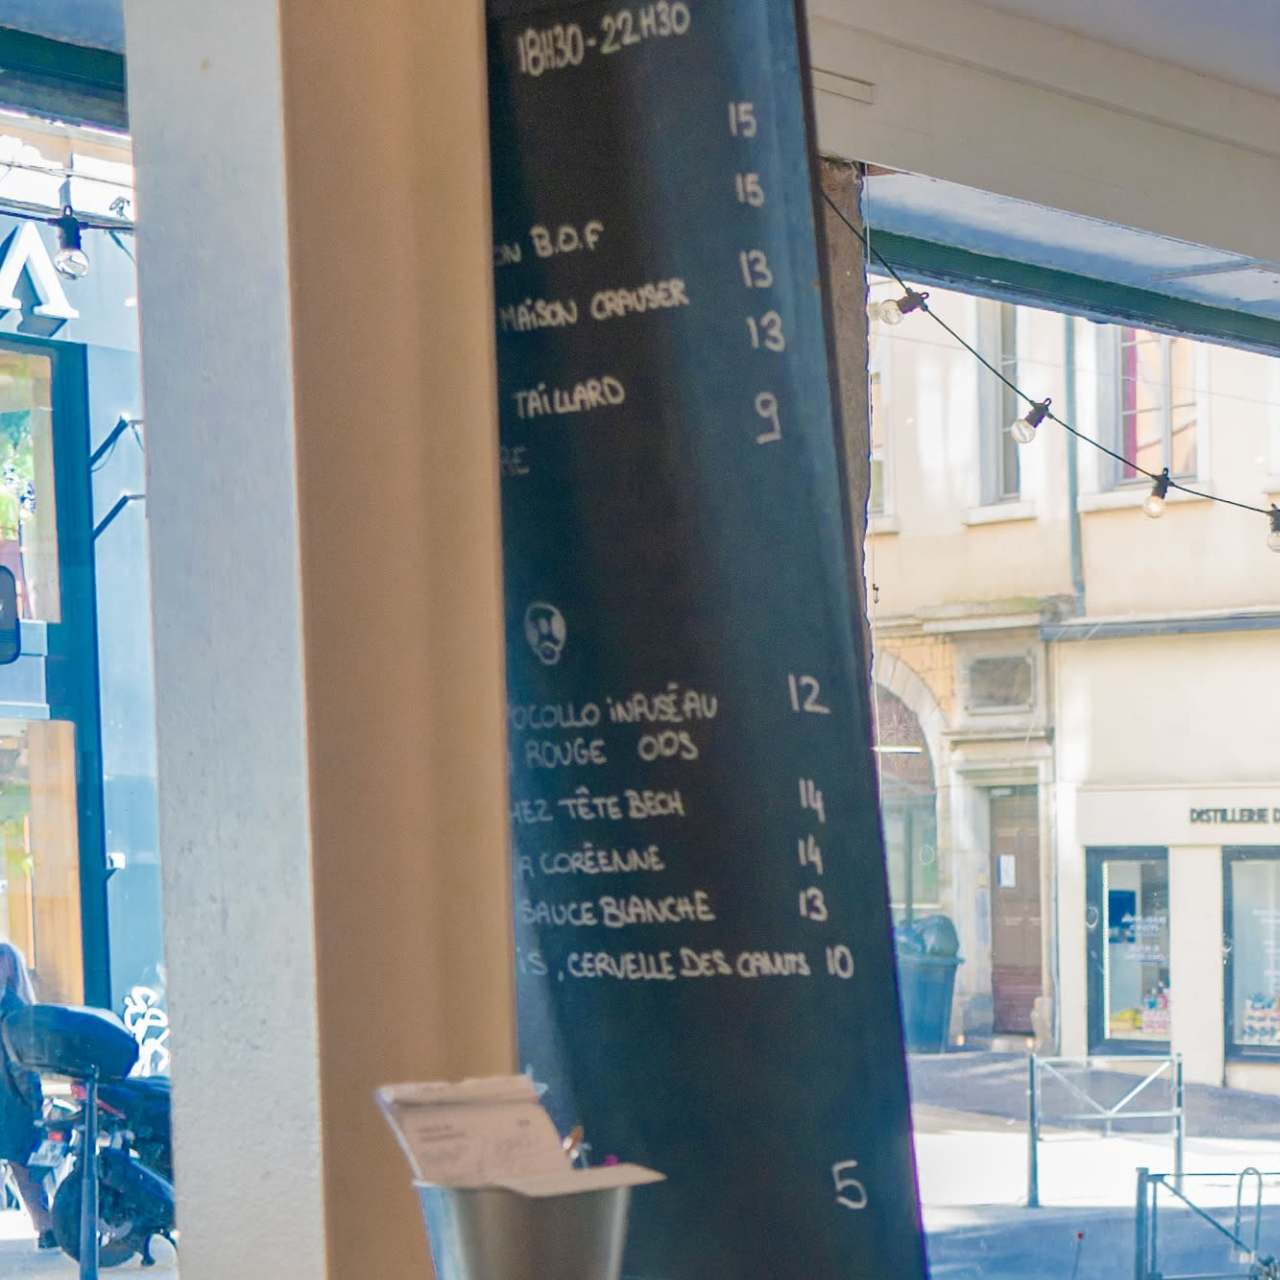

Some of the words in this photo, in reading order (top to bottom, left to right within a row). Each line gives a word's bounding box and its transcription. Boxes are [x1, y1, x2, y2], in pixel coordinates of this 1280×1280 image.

[728, 102, 757, 138] 15
[735, 173, 765, 208] 15
[740, 249, 773, 288] 13
[746, 310, 785, 352] 13
[788, 673, 832, 715] 12
[510, 702, 601, 730] OCOLLO
[525, 738, 608, 769] ROUGE
[799, 778, 826, 823] 14
[798, 834, 824, 876] 14
[600, 890, 716, 929] BLANCHE
[800, 886, 829, 922] 13
[825, 944, 855, 979] 10
[832, 1159, 868, 1210] 5
